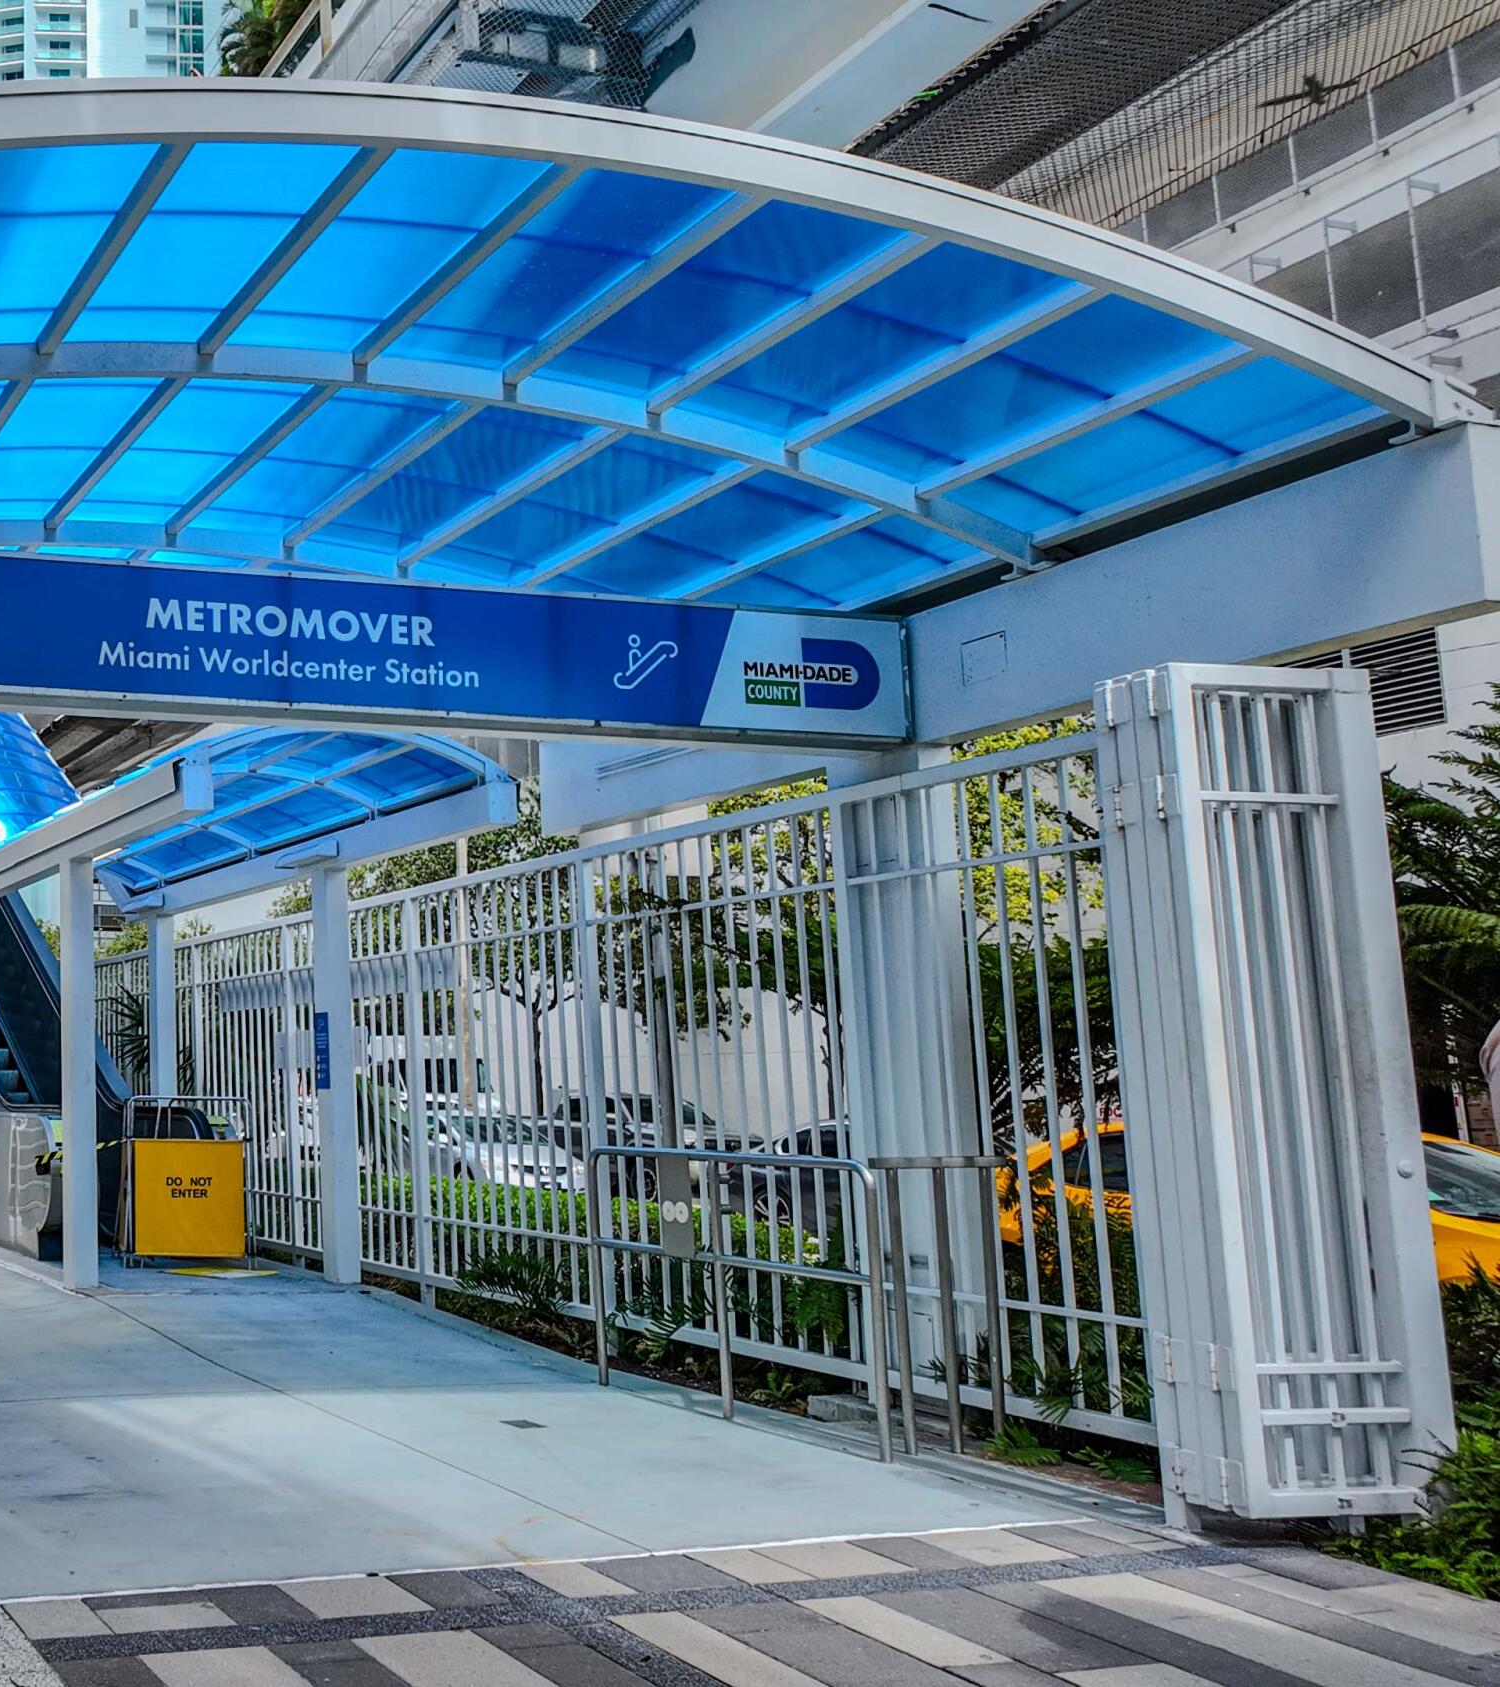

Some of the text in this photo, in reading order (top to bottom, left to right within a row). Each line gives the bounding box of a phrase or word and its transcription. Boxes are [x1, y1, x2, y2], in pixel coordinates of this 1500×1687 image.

[145, 597, 436, 647] METROMOVER
[98, 640, 480, 688] Miami Worldcenter Station
[747, 684, 798, 701] COUNTY
[166, 1176, 212, 1187] DO NOT
[171, 1188, 208, 1198] ENTER
